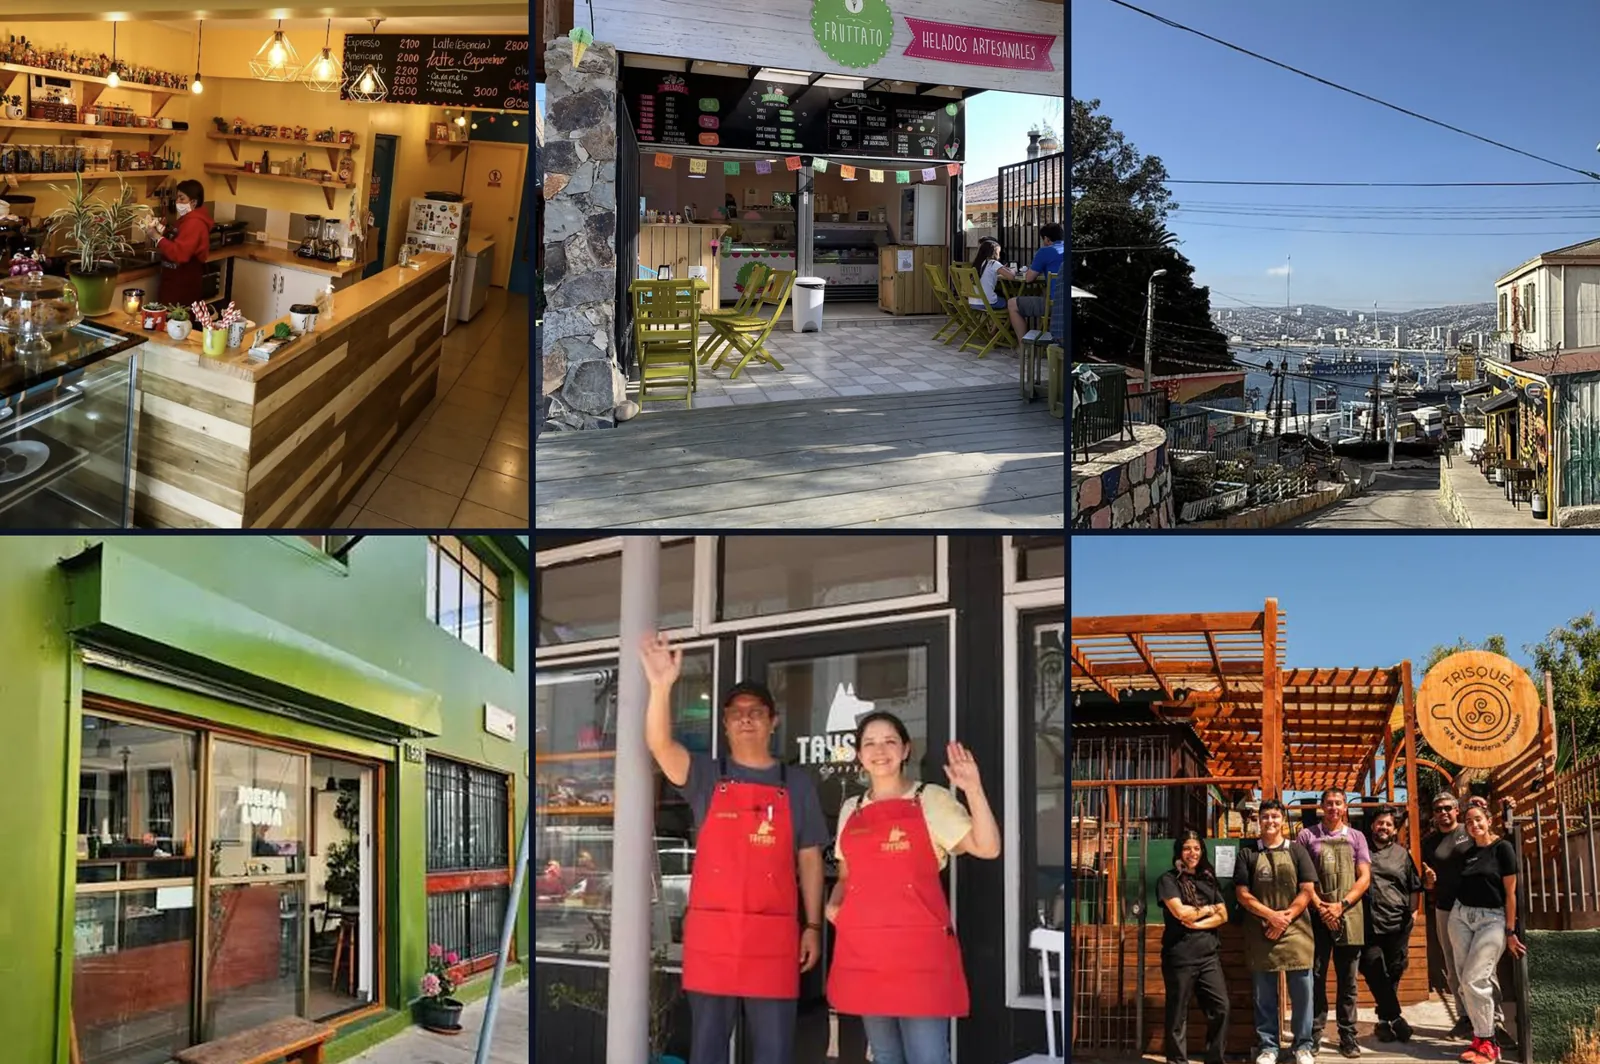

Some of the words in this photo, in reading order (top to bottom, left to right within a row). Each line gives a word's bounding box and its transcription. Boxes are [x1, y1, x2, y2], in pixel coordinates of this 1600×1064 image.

[824, 21, 883, 47] FRUTTATO
[346, 36, 380, 52] Expresso
[400, 38, 420, 49] 2100
[504, 40, 529, 50] 2800
[922, 31, 968, 53] HELADOS
[972, 37, 1036, 61] ARTESANALES
[345, 52, 384, 60] Americano
[396, 52, 420, 62] 2000
[395, 66, 418, 76] 2200
[394, 76, 417, 85] 2500
[392, 86, 418, 96] 2500
[473, 86, 498, 97] 3000
[1442, 666, 1516, 692] TRISQUEL
